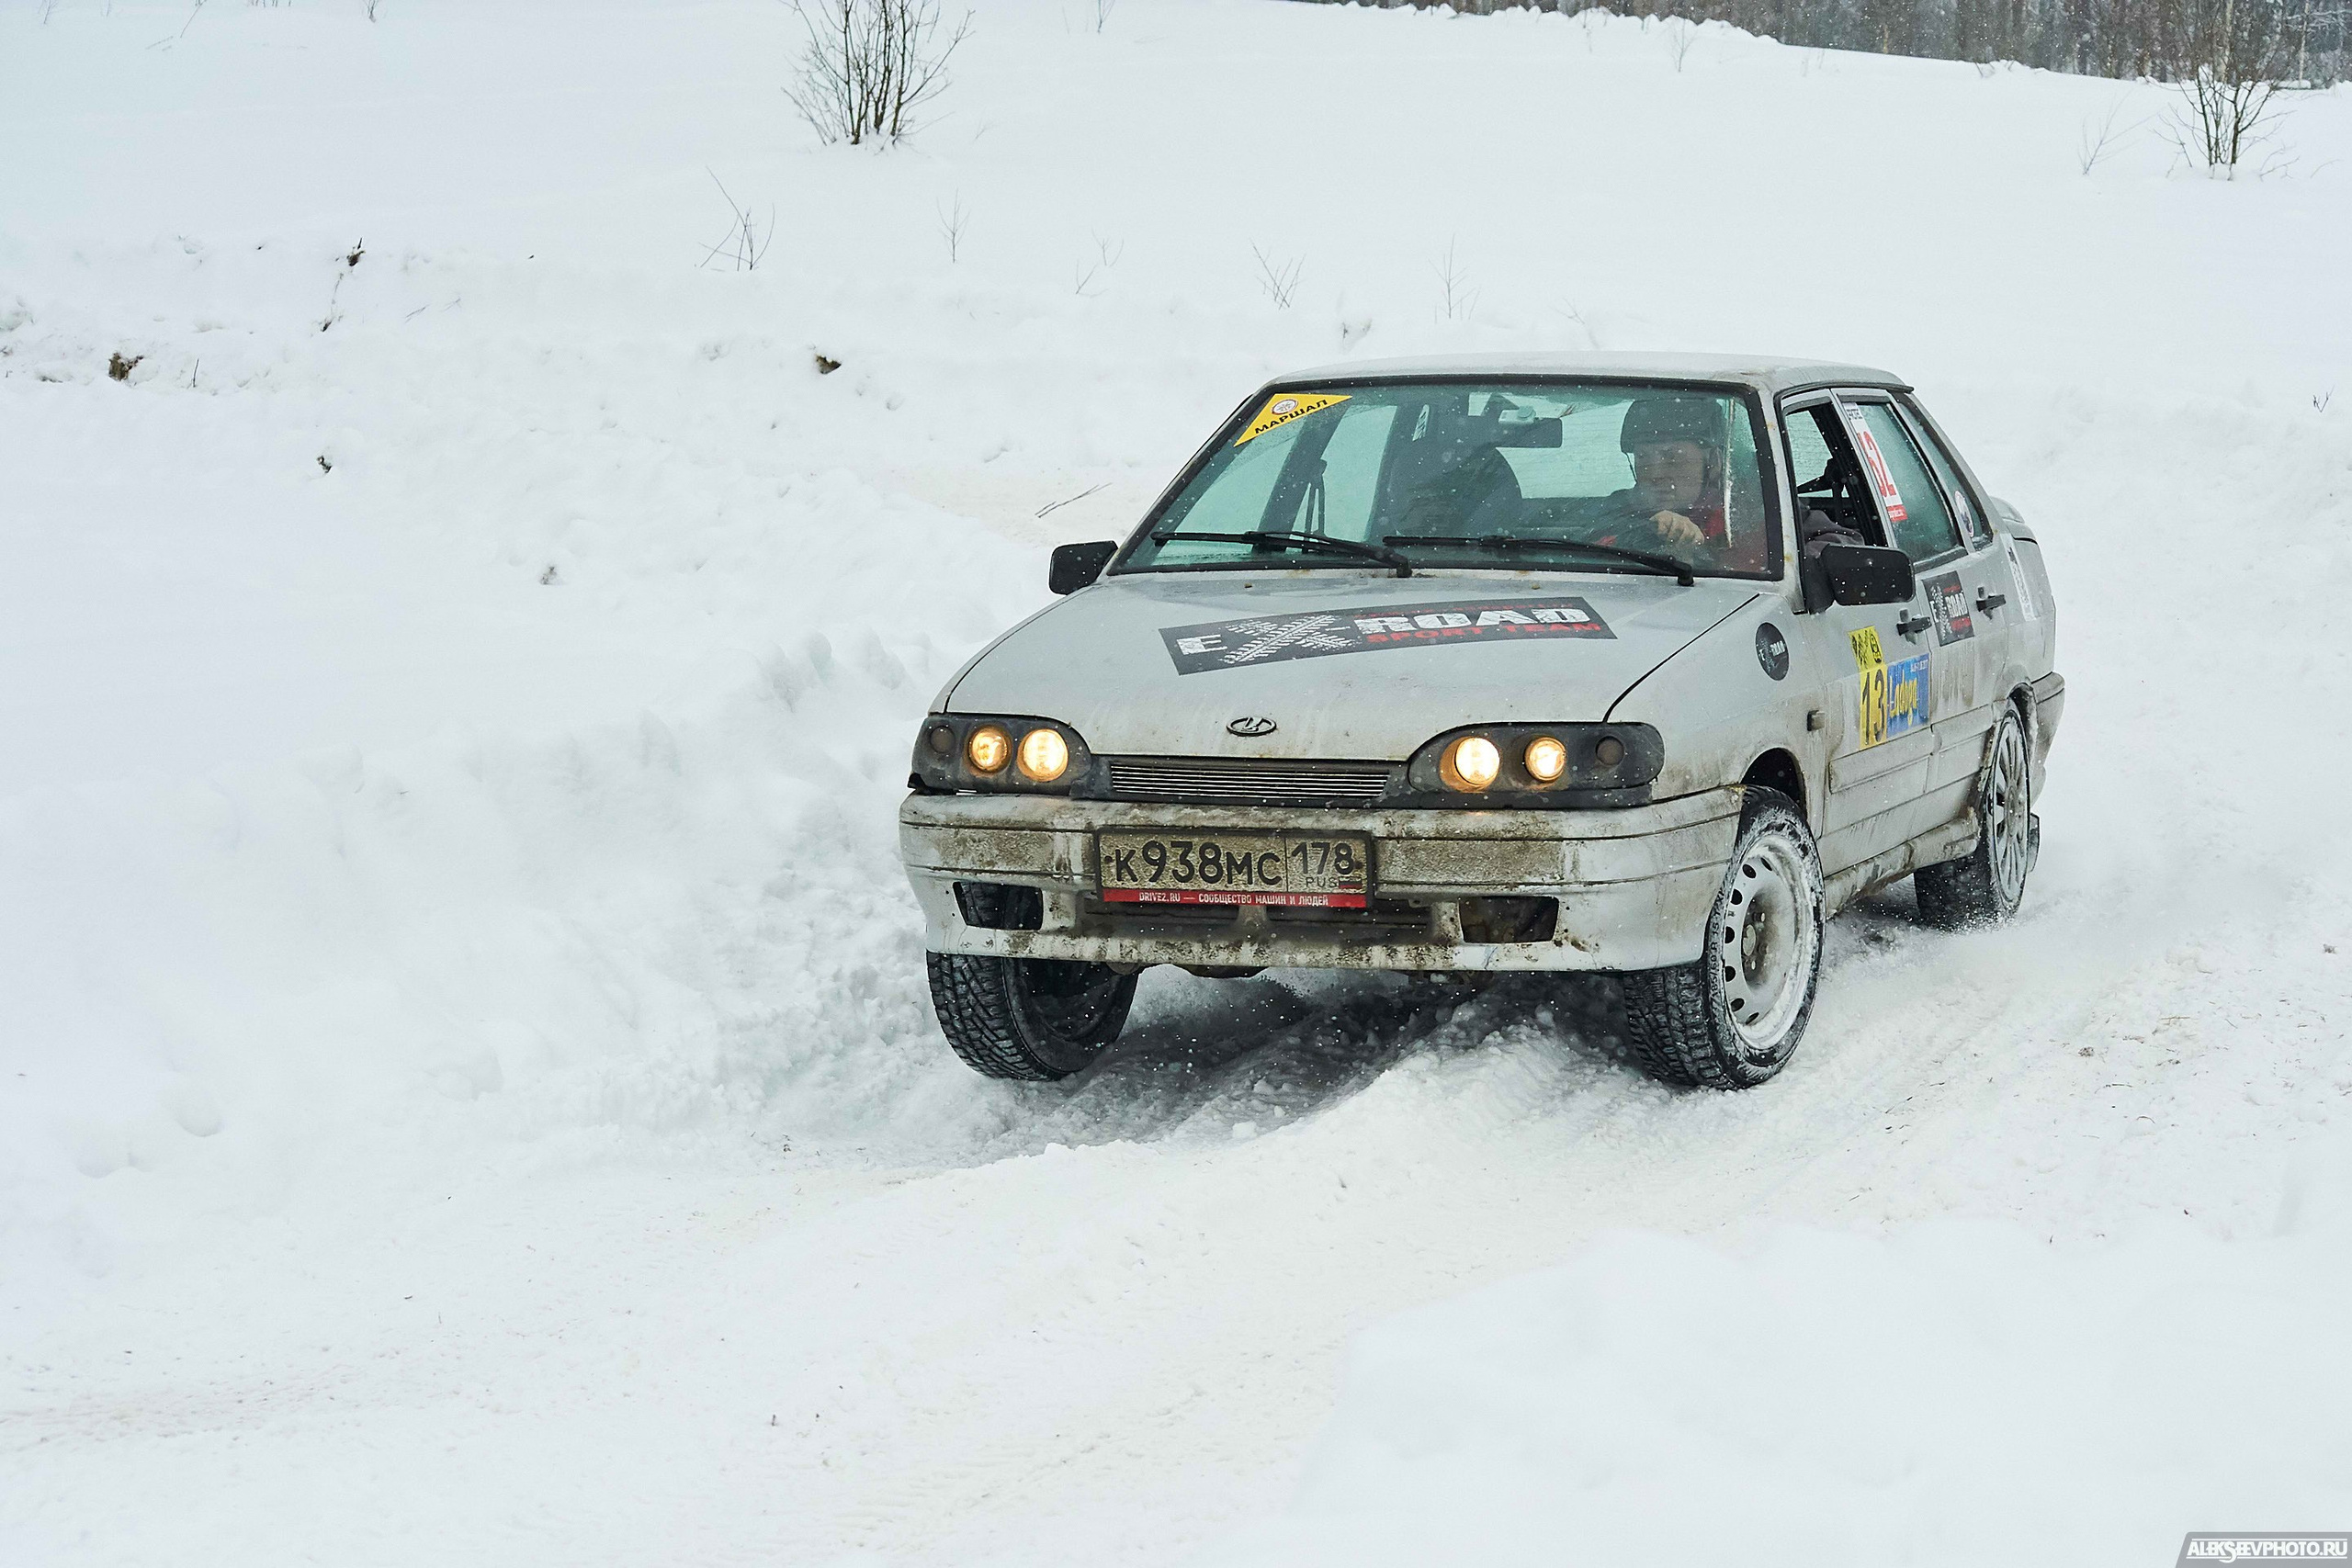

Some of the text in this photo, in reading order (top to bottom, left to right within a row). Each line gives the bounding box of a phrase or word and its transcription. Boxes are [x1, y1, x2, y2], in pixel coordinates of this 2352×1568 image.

[1254, 399, 1328, 434] МАРШАЛ
[1366, 626, 1489, 643] SPORT
[1502, 623, 1601, 633] TEAM
[1861, 669, 1885, 746] 13
[1290, 841, 1355, 875] 178
[1139, 892, 1182, 903] DRIVE2.RU
[1198, 893, 1252, 905] СООБЩЕСТВО
[1255, 895, 1286, 905] МАШИН
[1289, 896, 1296, 905] И
[1298, 895, 1329, 907] ЛЮДЕЙ
